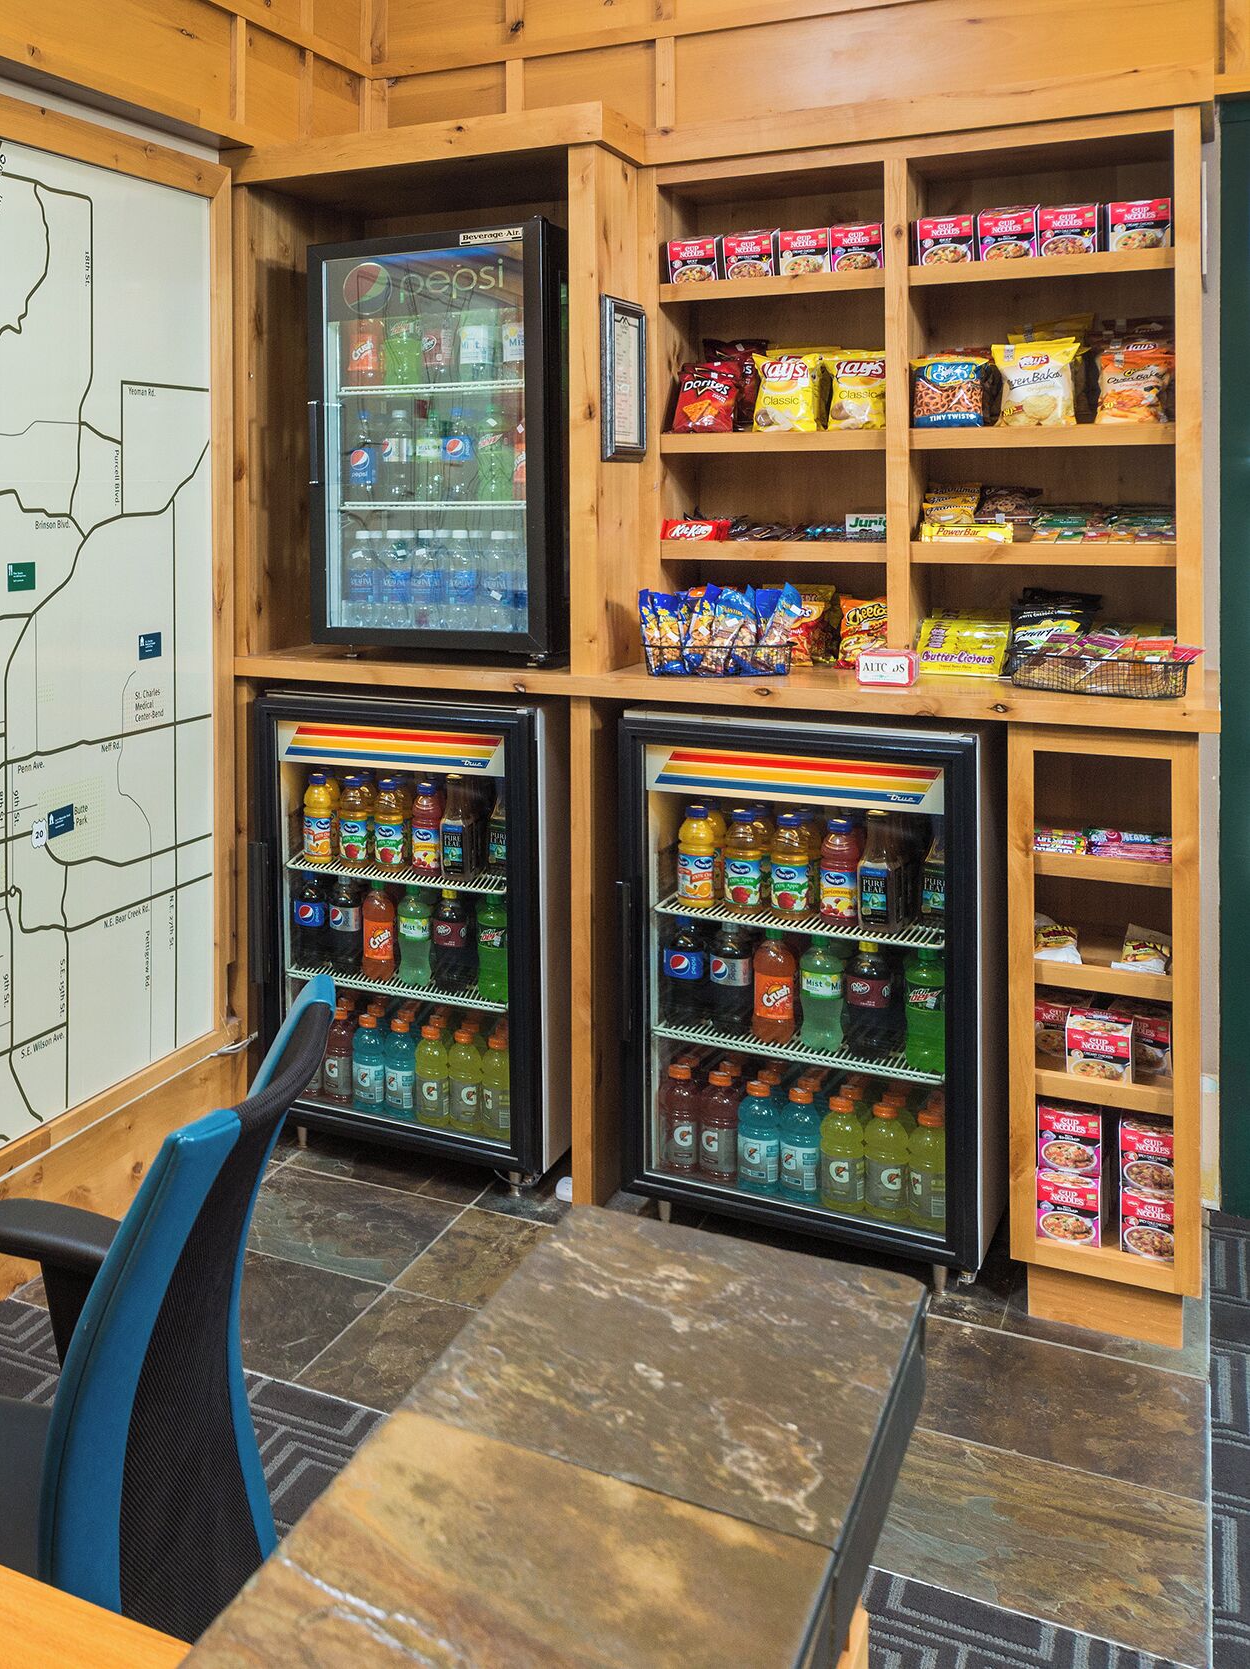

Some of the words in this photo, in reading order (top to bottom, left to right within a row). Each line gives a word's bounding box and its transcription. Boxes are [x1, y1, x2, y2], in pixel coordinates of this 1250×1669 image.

[1124, 211, 1156, 220] NOODLES
[1131, 207, 1149, 215] CUP
[998, 219, 1016, 227] CUP
[992, 224, 1022, 234] NOODLES
[400, 257, 505, 304] pepsi
[683, 378, 730, 395] Doritos
[838, 389, 877, 400] Classic
[763, 395, 800, 406] Classic
[929, 414, 948, 422] TINY
[936, 527, 981, 537] PowerBar
[35, 830, 44, 839] 20
[863, 878, 885, 887] PURE
[369, 928, 392, 949] Crush
[805, 978, 823, 988] Mist
[762, 985, 790, 1007] Crush
[1088, 1037, 1109, 1047] CUP
[1081, 1042, 1116, 1054] NOODLES
[1060, 1117, 1079, 1126] CUP
[1052, 1122, 1086, 1134] NOODLES
[1143, 1137, 1163, 1147] CUP
[1135, 1143, 1171, 1155] NOODLES
